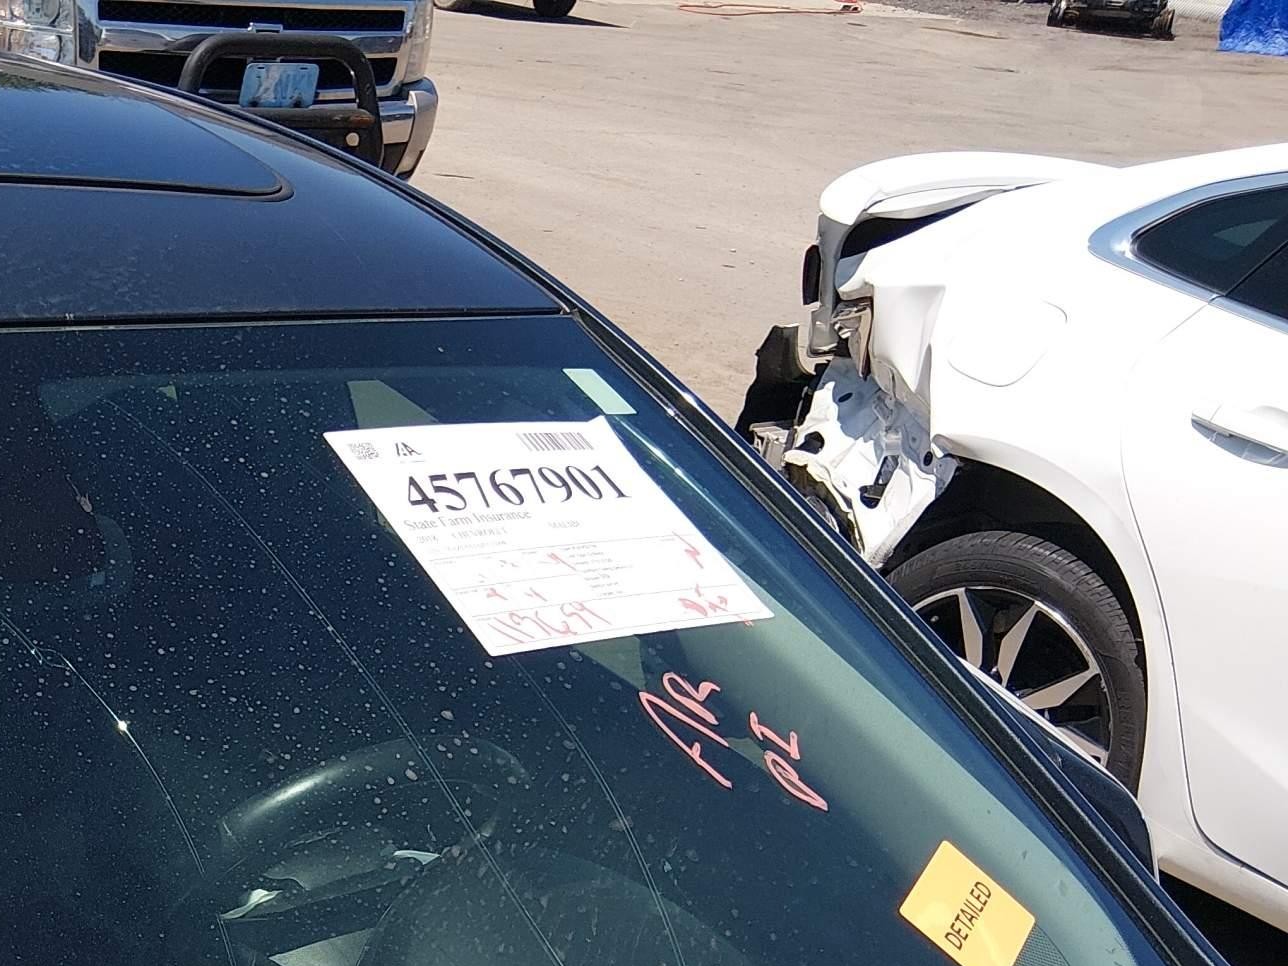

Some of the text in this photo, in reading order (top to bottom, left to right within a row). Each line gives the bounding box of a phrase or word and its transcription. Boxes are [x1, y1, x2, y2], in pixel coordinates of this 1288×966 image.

[407, 465, 631, 513] 45767901
[403, 509, 532, 531] State Farm Insurance
[944, 881, 992, 951] DETAILED
